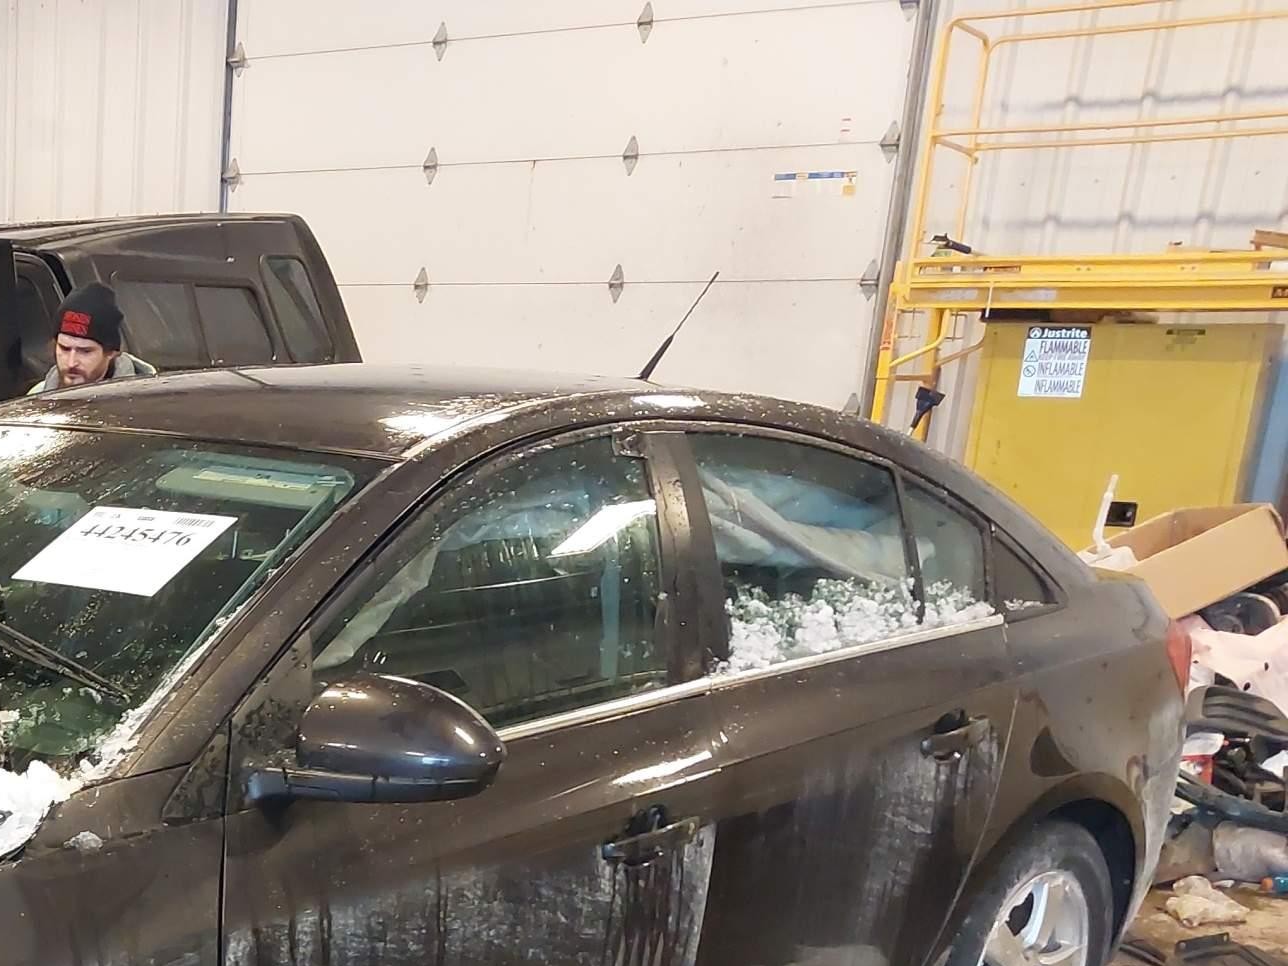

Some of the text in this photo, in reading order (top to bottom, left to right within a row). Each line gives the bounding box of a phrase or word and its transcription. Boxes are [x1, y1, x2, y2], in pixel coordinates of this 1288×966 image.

[1042, 328, 1088, 338] Justrite
[1040, 340, 1088, 353] FLAMMABLE
[1037, 362, 1084, 376] INFLAMABLE
[80, 524, 194, 546] 44245476
